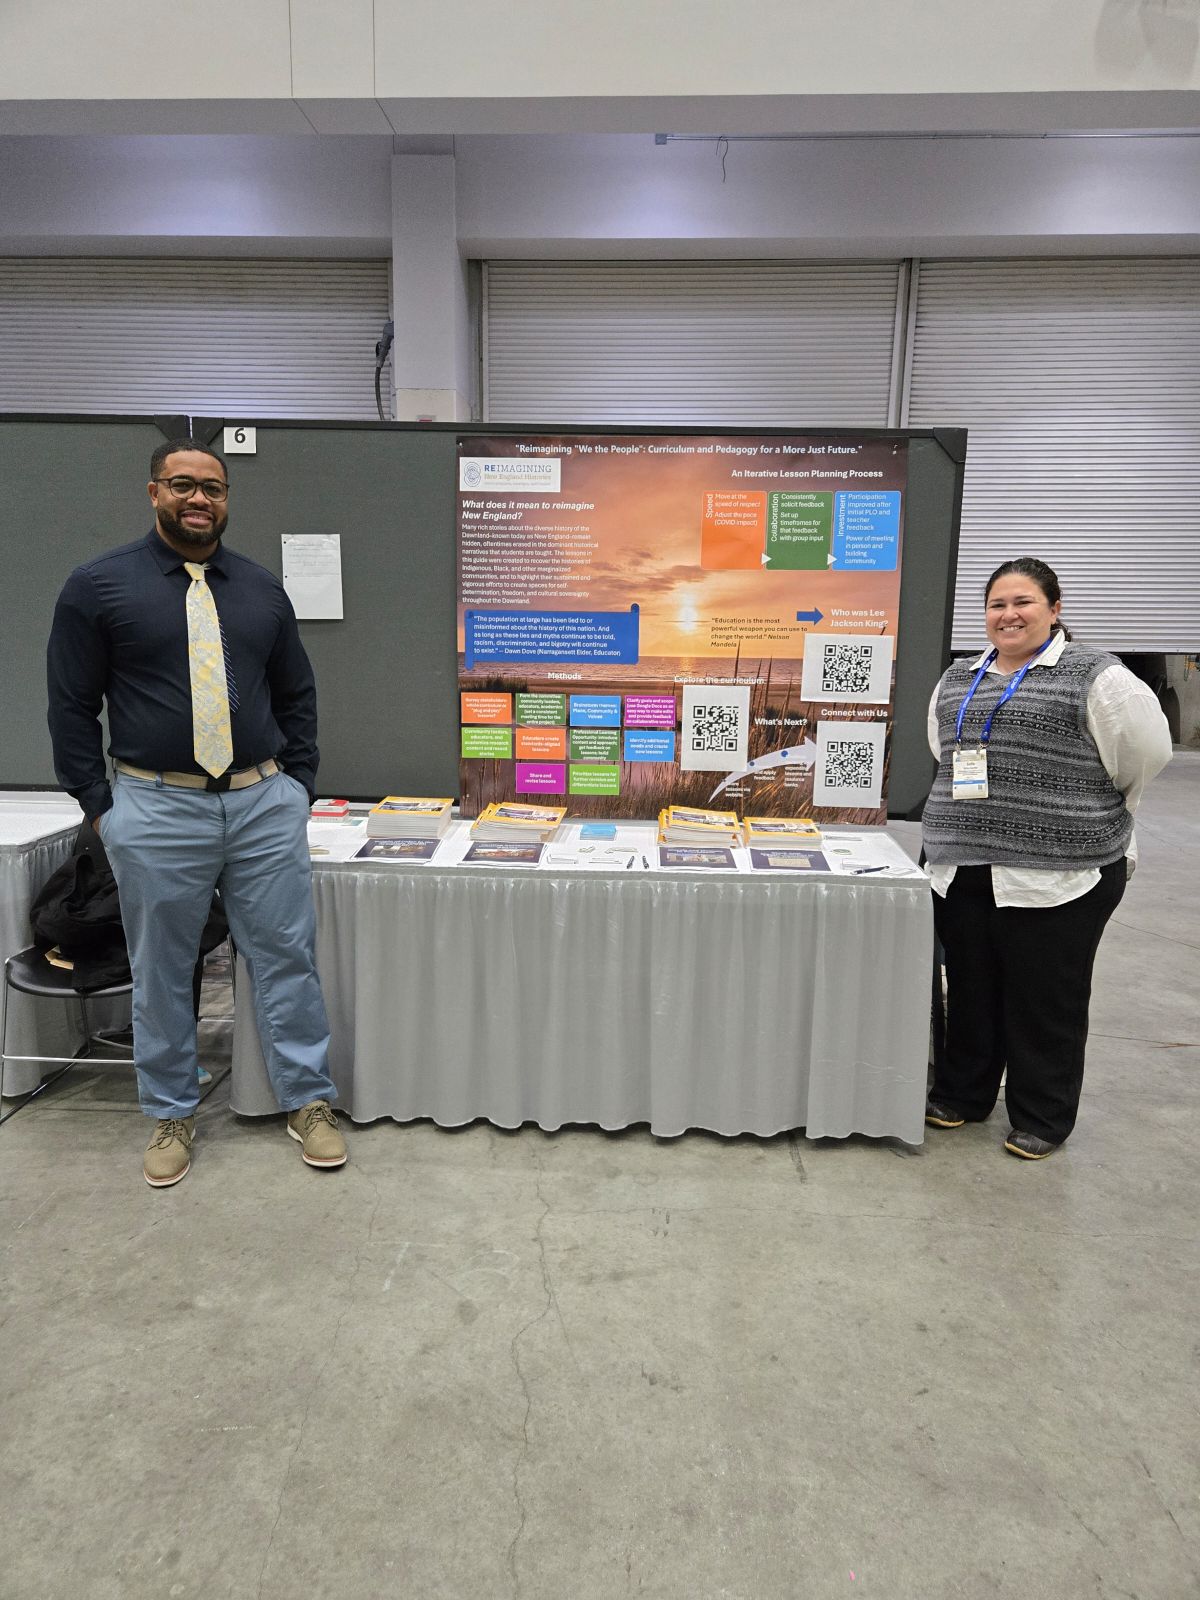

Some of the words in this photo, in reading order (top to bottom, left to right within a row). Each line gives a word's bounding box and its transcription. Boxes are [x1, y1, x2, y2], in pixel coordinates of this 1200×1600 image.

[234, 428, 246, 444] 6
[516, 444, 572, 454] "Reimagining
[610, 445, 646, 454] People":
[715, 445, 758, 455] Pedagogy
[783, 445, 805, 453] More
[807, 445, 826, 453] Just
[828, 445, 862, 454] Future."
[811, 470, 847, 479] Planning
[552, 501, 594, 511] reimagine
[483, 511, 522, 521] England?
[770, 494, 779, 542] Collaboration
[838, 494, 846, 537] Investment
[830, 620, 863, 628] Jackson
[865, 620, 888, 628] King?
[711, 625, 737, 634] powerful
[710, 633, 732, 641] change
[674, 676, 704, 685] Explore
[821, 708, 855, 717] Connect
[857, 709, 875, 717] with
[754, 718, 782, 726] What's
[784, 718, 808, 726] Next?
